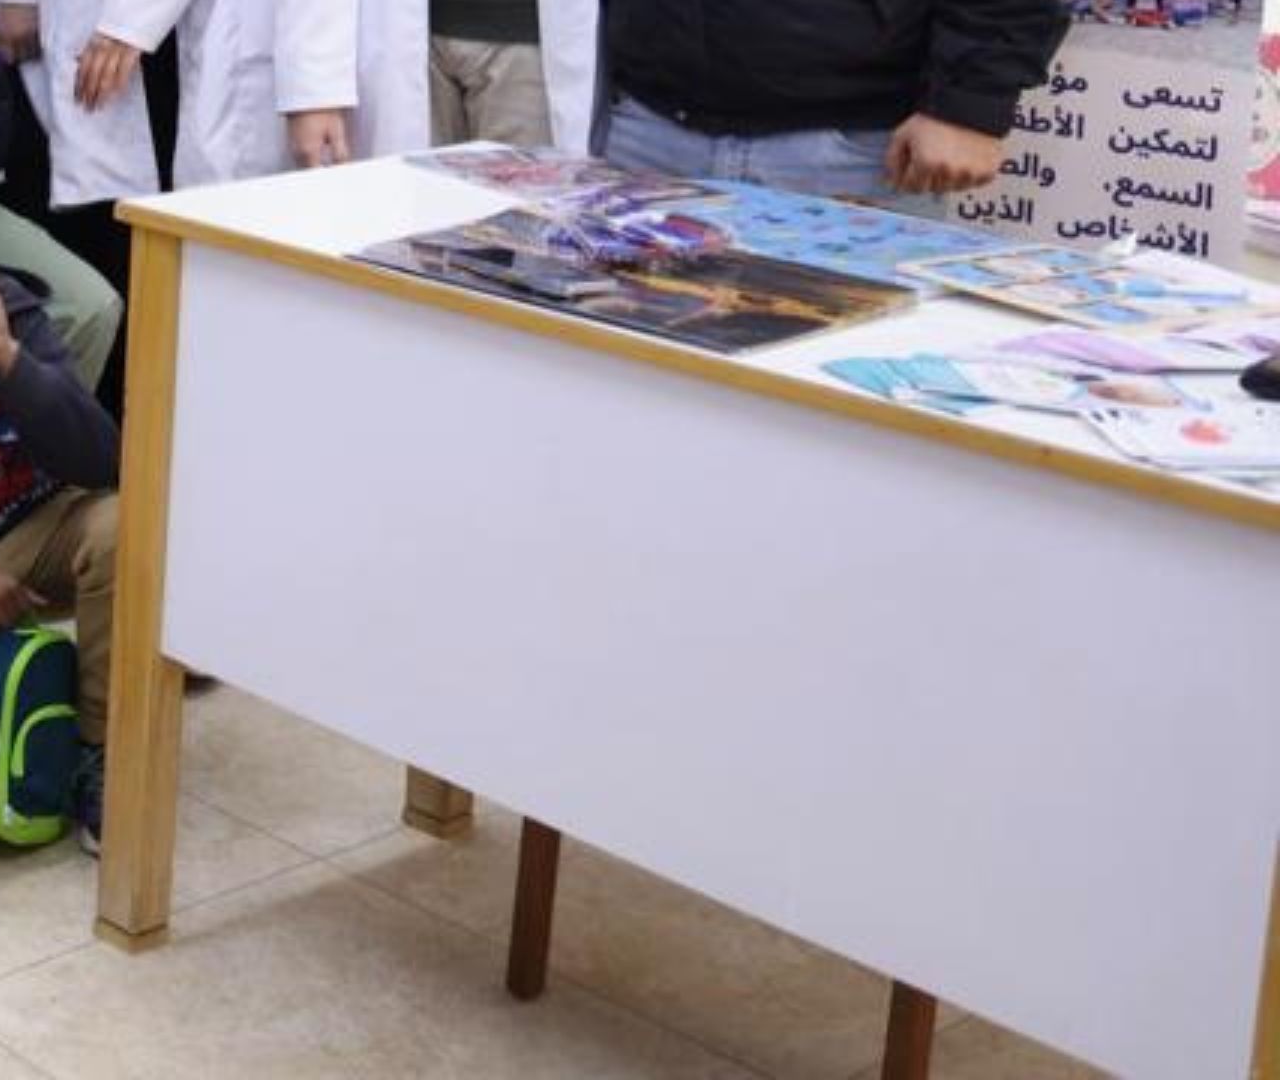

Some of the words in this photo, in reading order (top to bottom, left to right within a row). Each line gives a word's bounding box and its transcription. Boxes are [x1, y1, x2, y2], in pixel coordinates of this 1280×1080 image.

[1049, 62, 1088, 95] مؤ
[1122, 85, 1223, 113] تسعى
[1012, 105, 1085, 140] الأطف
[1108, 126, 1218, 162] لتمكين
[957, 194, 1034, 224] الذين
